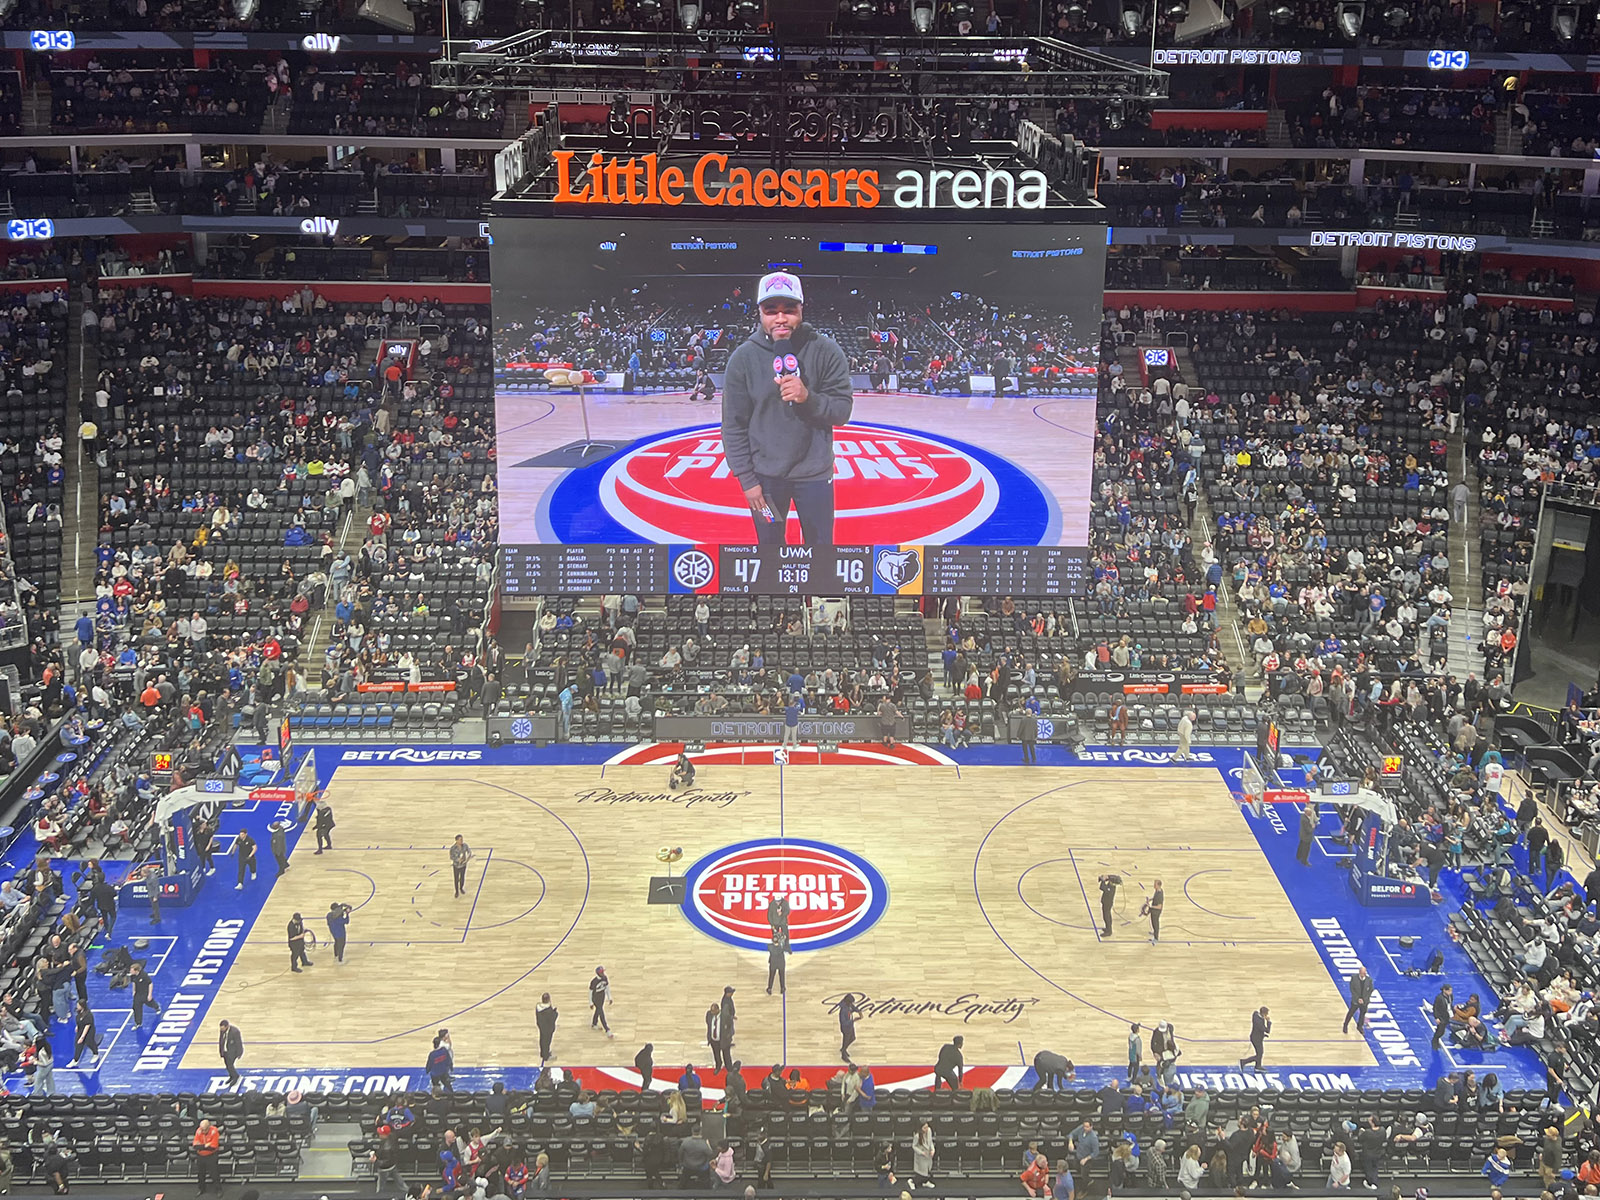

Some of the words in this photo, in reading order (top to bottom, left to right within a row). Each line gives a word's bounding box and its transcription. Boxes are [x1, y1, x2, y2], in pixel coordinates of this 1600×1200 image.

[31, 31, 75, 50] 313
[303, 33, 341, 53] ally
[1154, 50, 1228, 65] DETROIT
[1230, 50, 1301, 65] PISTONS
[1429, 50, 1468, 69] 313
[552, 150, 684, 206] Little
[692, 151, 880, 207] Caesars
[893, 168, 1048, 209] arena
[8, 219, 54, 239] 313
[301, 217, 340, 236] ally
[599, 242, 617, 251] ally
[671, 242, 704, 250] DETROIT
[705, 242, 737, 250] PISTONS
[1310, 231, 1391, 247] DETROIT
[1393, 233, 1477, 252] PISTONS
[1011, 250, 1045, 259] DETROIT
[388, 345, 408, 356] ally
[1145, 351, 1168, 364] 313
[752, 546, 758, 554] 5
[779, 547, 813, 559] UWM
[865, 546, 870, 555] 5
[735, 559, 761, 582] 47
[778, 569, 809, 582] 13:19
[836, 559, 864, 583] 46
[743, 585, 749, 593] 0
[789, 585, 798, 593] 24
[711, 721, 784, 735] DETROIT
[797, 721, 856, 735] ISTONS
[574, 788, 671, 805] Platinum
[671, 789, 740, 808] Equity
[722, 873, 843, 891] DETROIT
[1371, 885, 1401, 893] BELFOR
[721, 892, 846, 911] PISTONS
[132, 992, 205, 1072] DETROIT
[181, 918, 245, 988] PISTONS
[944, 993, 1027, 1024] Equity
